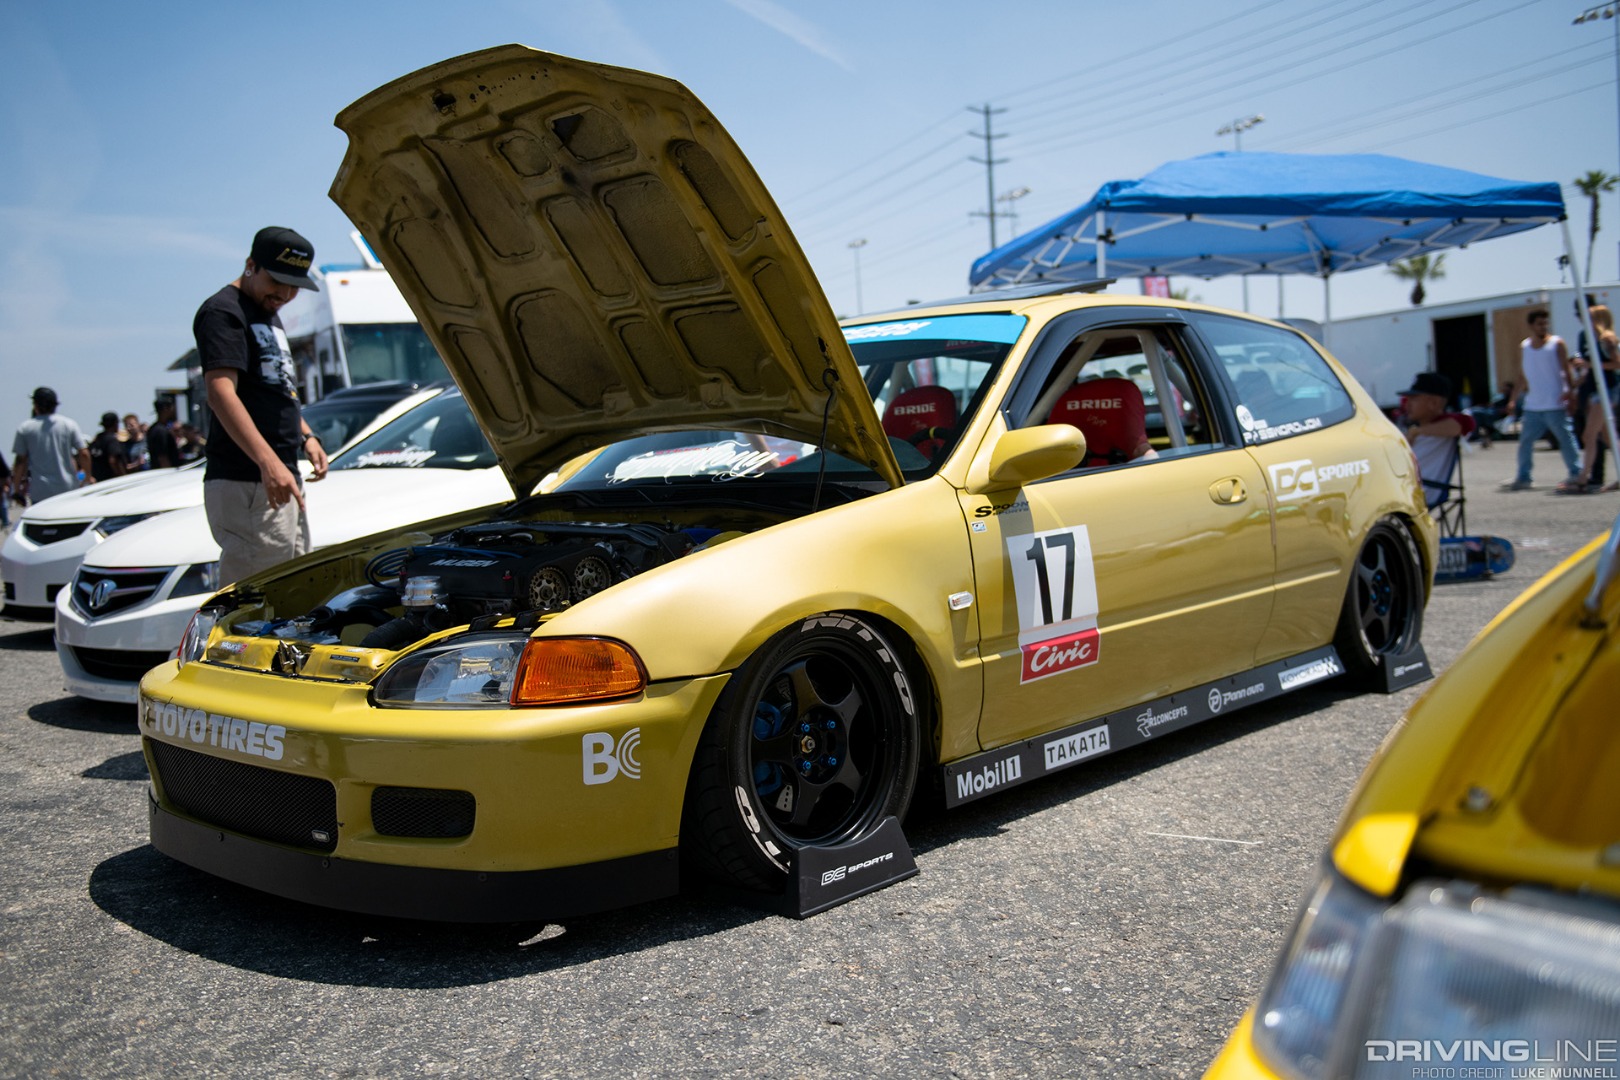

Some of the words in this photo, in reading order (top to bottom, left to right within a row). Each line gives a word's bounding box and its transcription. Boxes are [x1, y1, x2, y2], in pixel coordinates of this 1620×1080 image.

[894, 402, 937, 416] BRIDE
[1066, 398, 1122, 411] BRIDE
[1318, 459, 1370, 483] SPORTS
[974, 501, 1029, 518] SPOON
[1026, 532, 1075, 626] 17
[1031, 641, 1092, 673] Civic
[154, 701, 207, 744] TOYO
[210, 714, 287, 761] TIRES
[1046, 730, 1108, 764] TAKATA
[957, 760, 1006, 799] Mobil
[821, 866, 847, 886] DC
[848, 852, 894, 873] SPORTS
